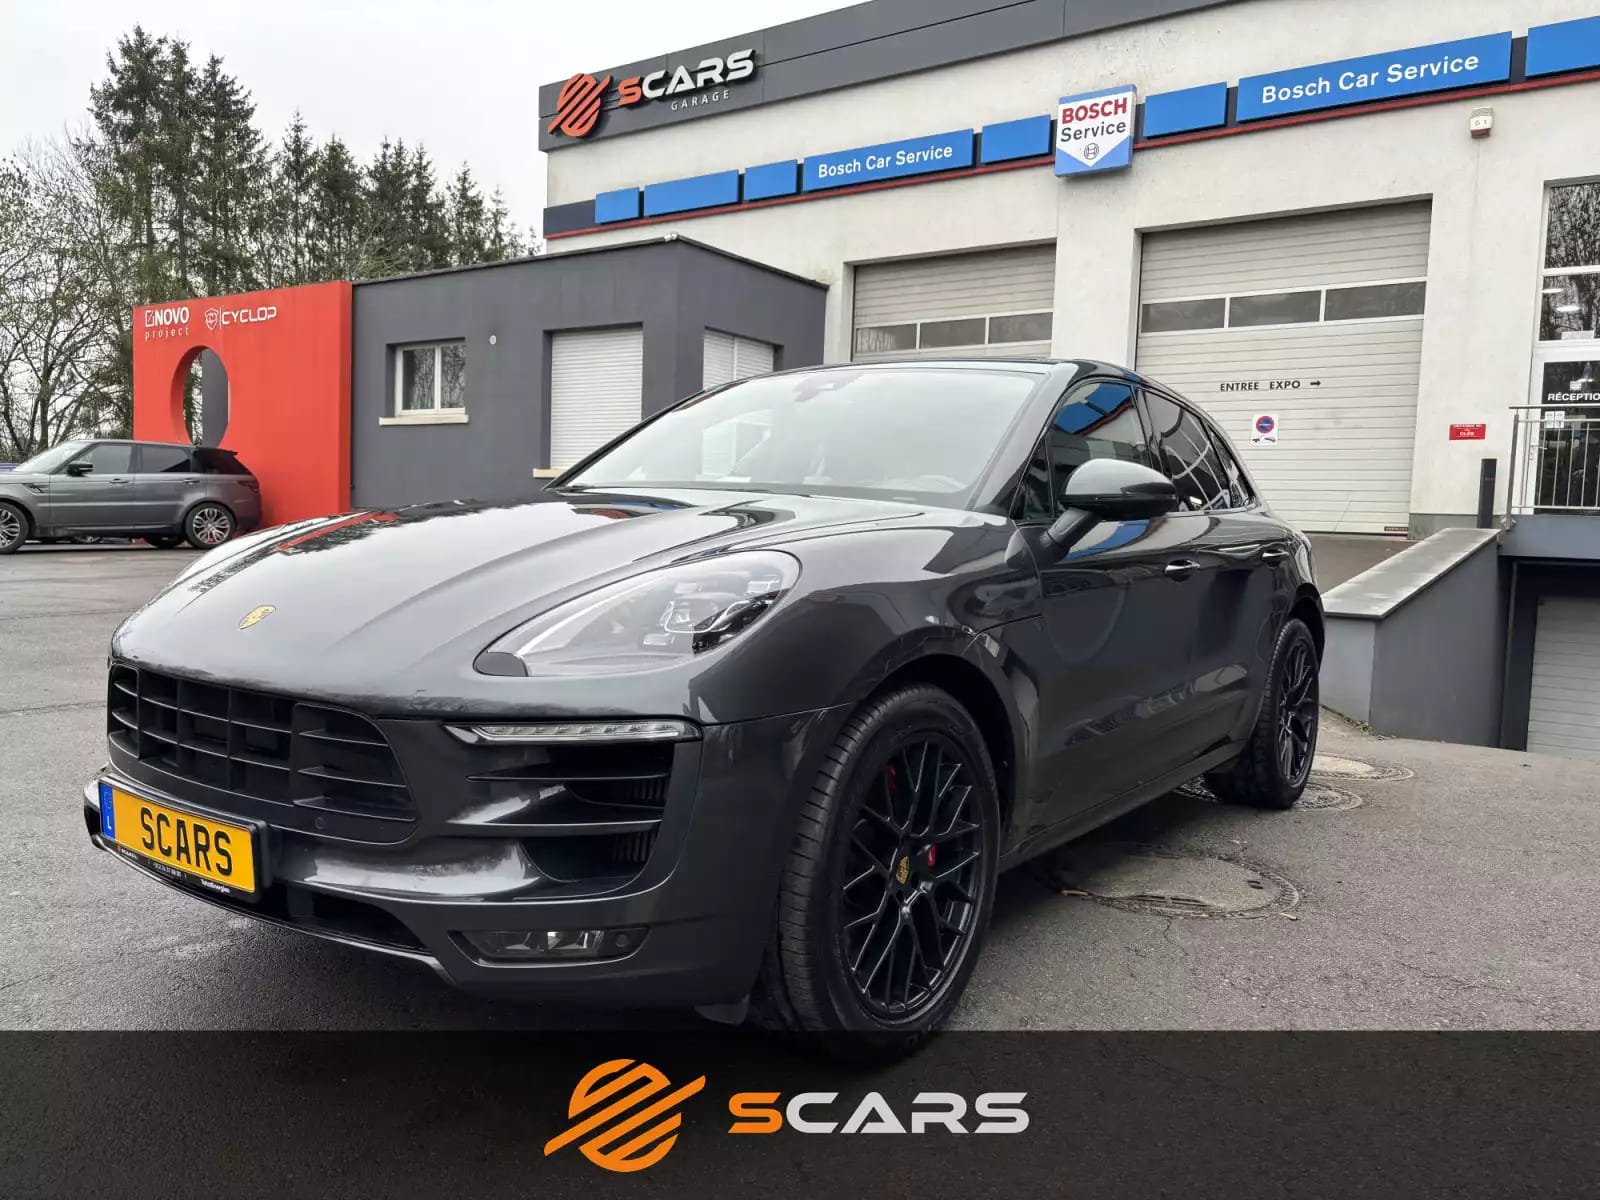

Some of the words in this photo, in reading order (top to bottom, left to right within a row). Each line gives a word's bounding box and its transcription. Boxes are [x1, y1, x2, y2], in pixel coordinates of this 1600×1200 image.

[618, 48, 756, 106] SCARS
[1262, 77, 1330, 104] Bosch
[1338, 71, 1379, 91] Car
[1387, 55, 1479, 83] Service
[671, 89, 730, 111] GARAGE
[1061, 97, 1127, 125] BOSCH
[1060, 121, 1126, 143] Service
[818, 159, 861, 178] Bosch
[865, 155, 891, 171] Car
[895, 146, 953, 165] Service
[221, 306, 277, 325] CYCLOP
[145, 326, 189, 342] project
[1220, 382, 1259, 392] ENTREE
[1269, 380, 1301, 390] EXPO
[106, 819, 112, 830] L
[140, 806, 233, 876] SCARS
